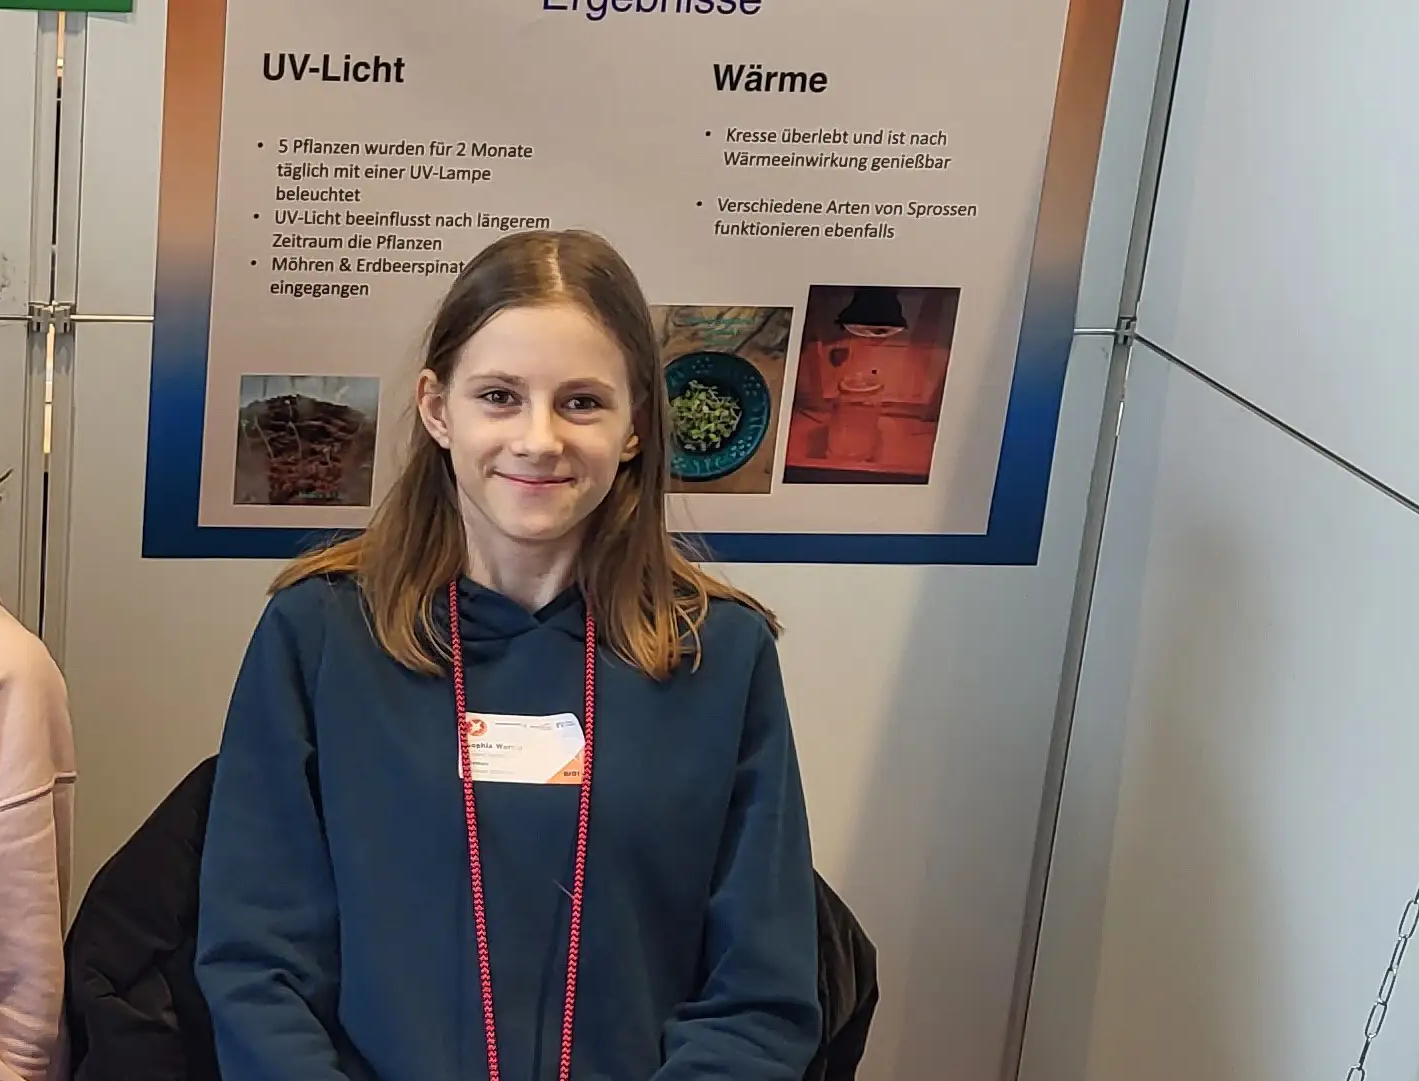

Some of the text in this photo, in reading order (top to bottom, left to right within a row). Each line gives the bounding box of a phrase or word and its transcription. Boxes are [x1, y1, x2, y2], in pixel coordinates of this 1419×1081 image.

[262, 53, 406, 83] UV-Licht
[713, 63, 828, 93] Wärme
[726, 127, 947, 146] Kresse überlebt und ist nach
[278, 138, 533, 159] 5 Pflanzen wurden für 2 Monate
[723, 151, 952, 171] Wärmeeinwirkung genießbar
[276, 163, 492, 184] täglich mit einer UV-Lampe
[275, 186, 361, 203] beleuchtet
[717, 197, 978, 219] Verschiedene Arten von Sprossen
[274, 210, 551, 232] UV-Licht beeinflusst nach längerem
[713, 220, 895, 239] funktionieren ebenfalls
[271, 233, 443, 251] Zeitraum die Pflanzen
[271, 256, 465, 277] Möhren & Erdbeerspinat
[270, 280, 370, 298] eingegangen
